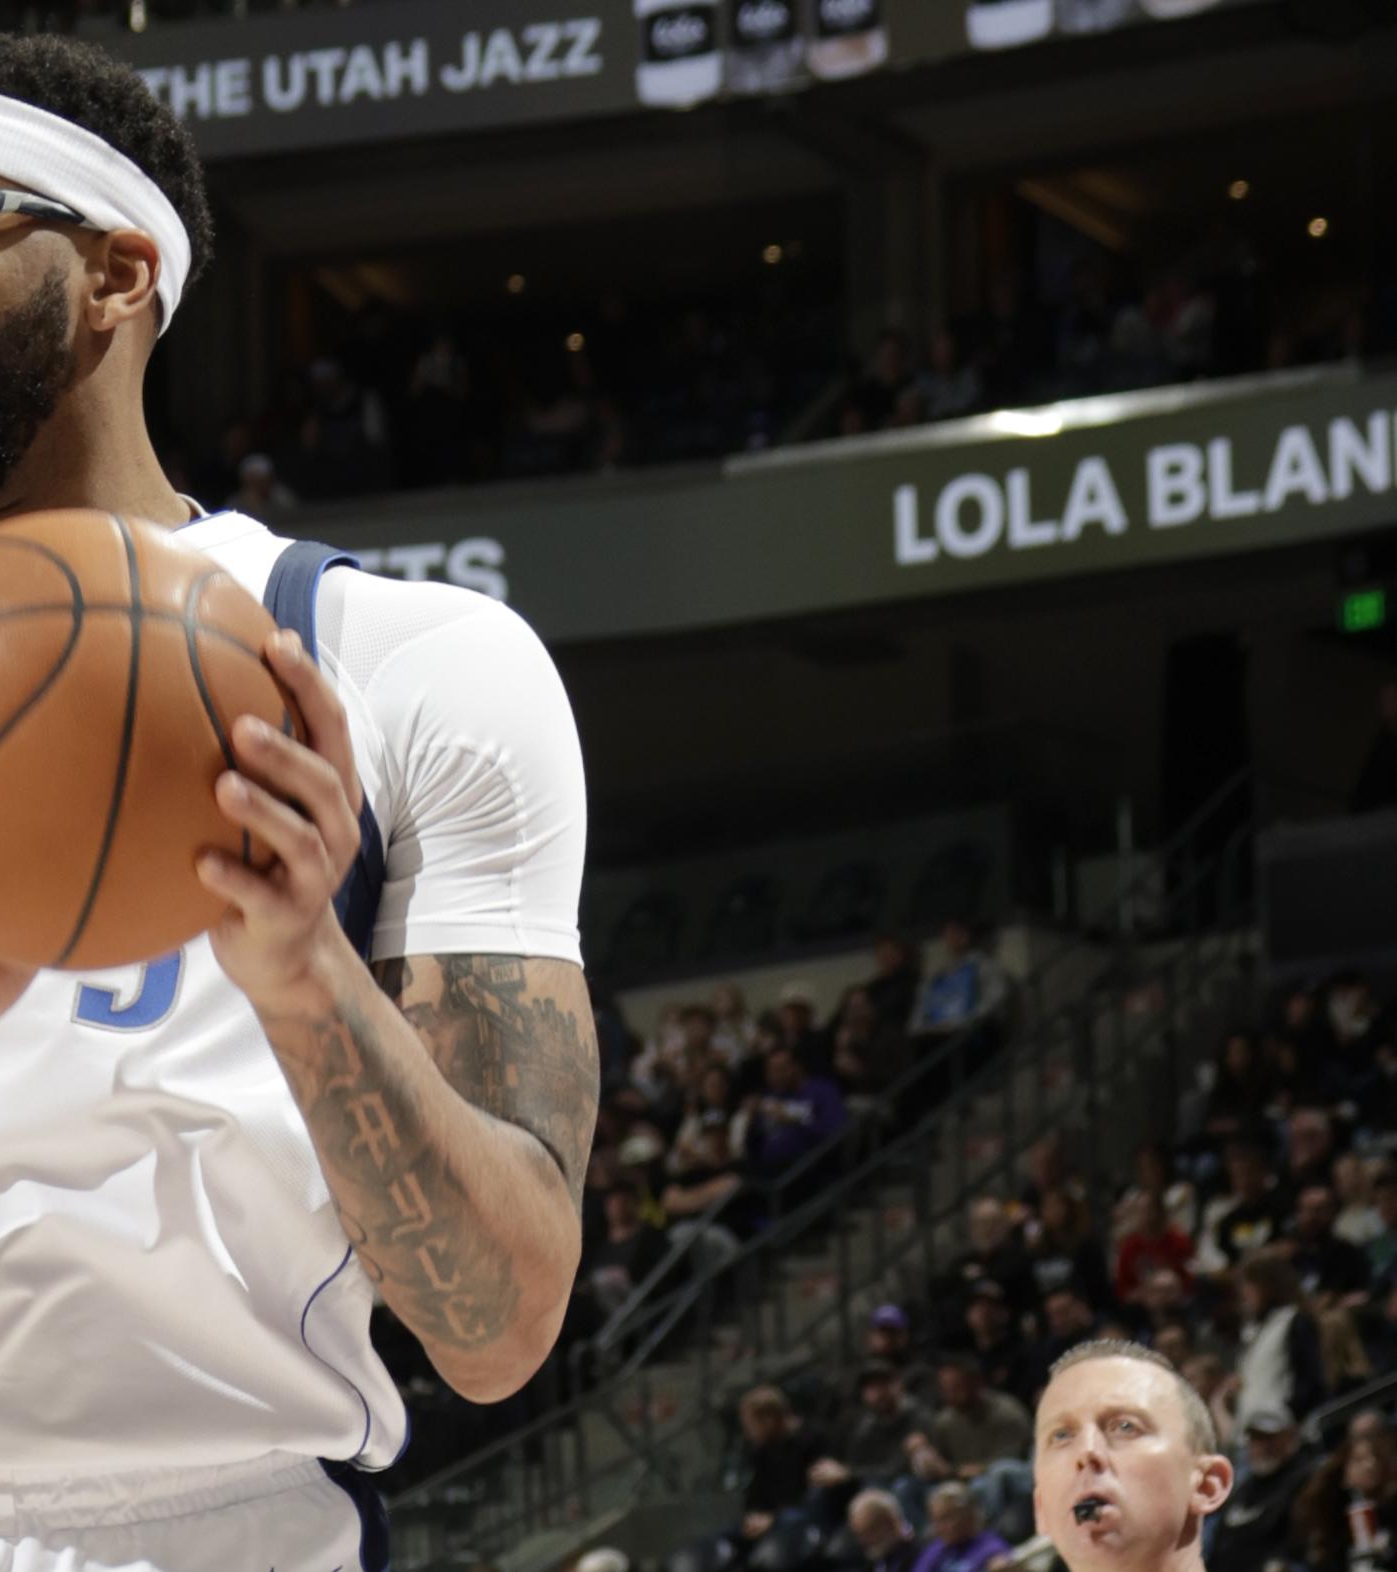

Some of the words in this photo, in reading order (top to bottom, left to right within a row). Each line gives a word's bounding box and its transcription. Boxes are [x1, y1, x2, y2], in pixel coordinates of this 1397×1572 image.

[137, 59, 251, 120] THE
[263, 38, 428, 111] UTAH
[440, 17, 601, 91] JAZZ
[893, 456, 1129, 566] LOLA
[359, 537, 508, 601] TS
